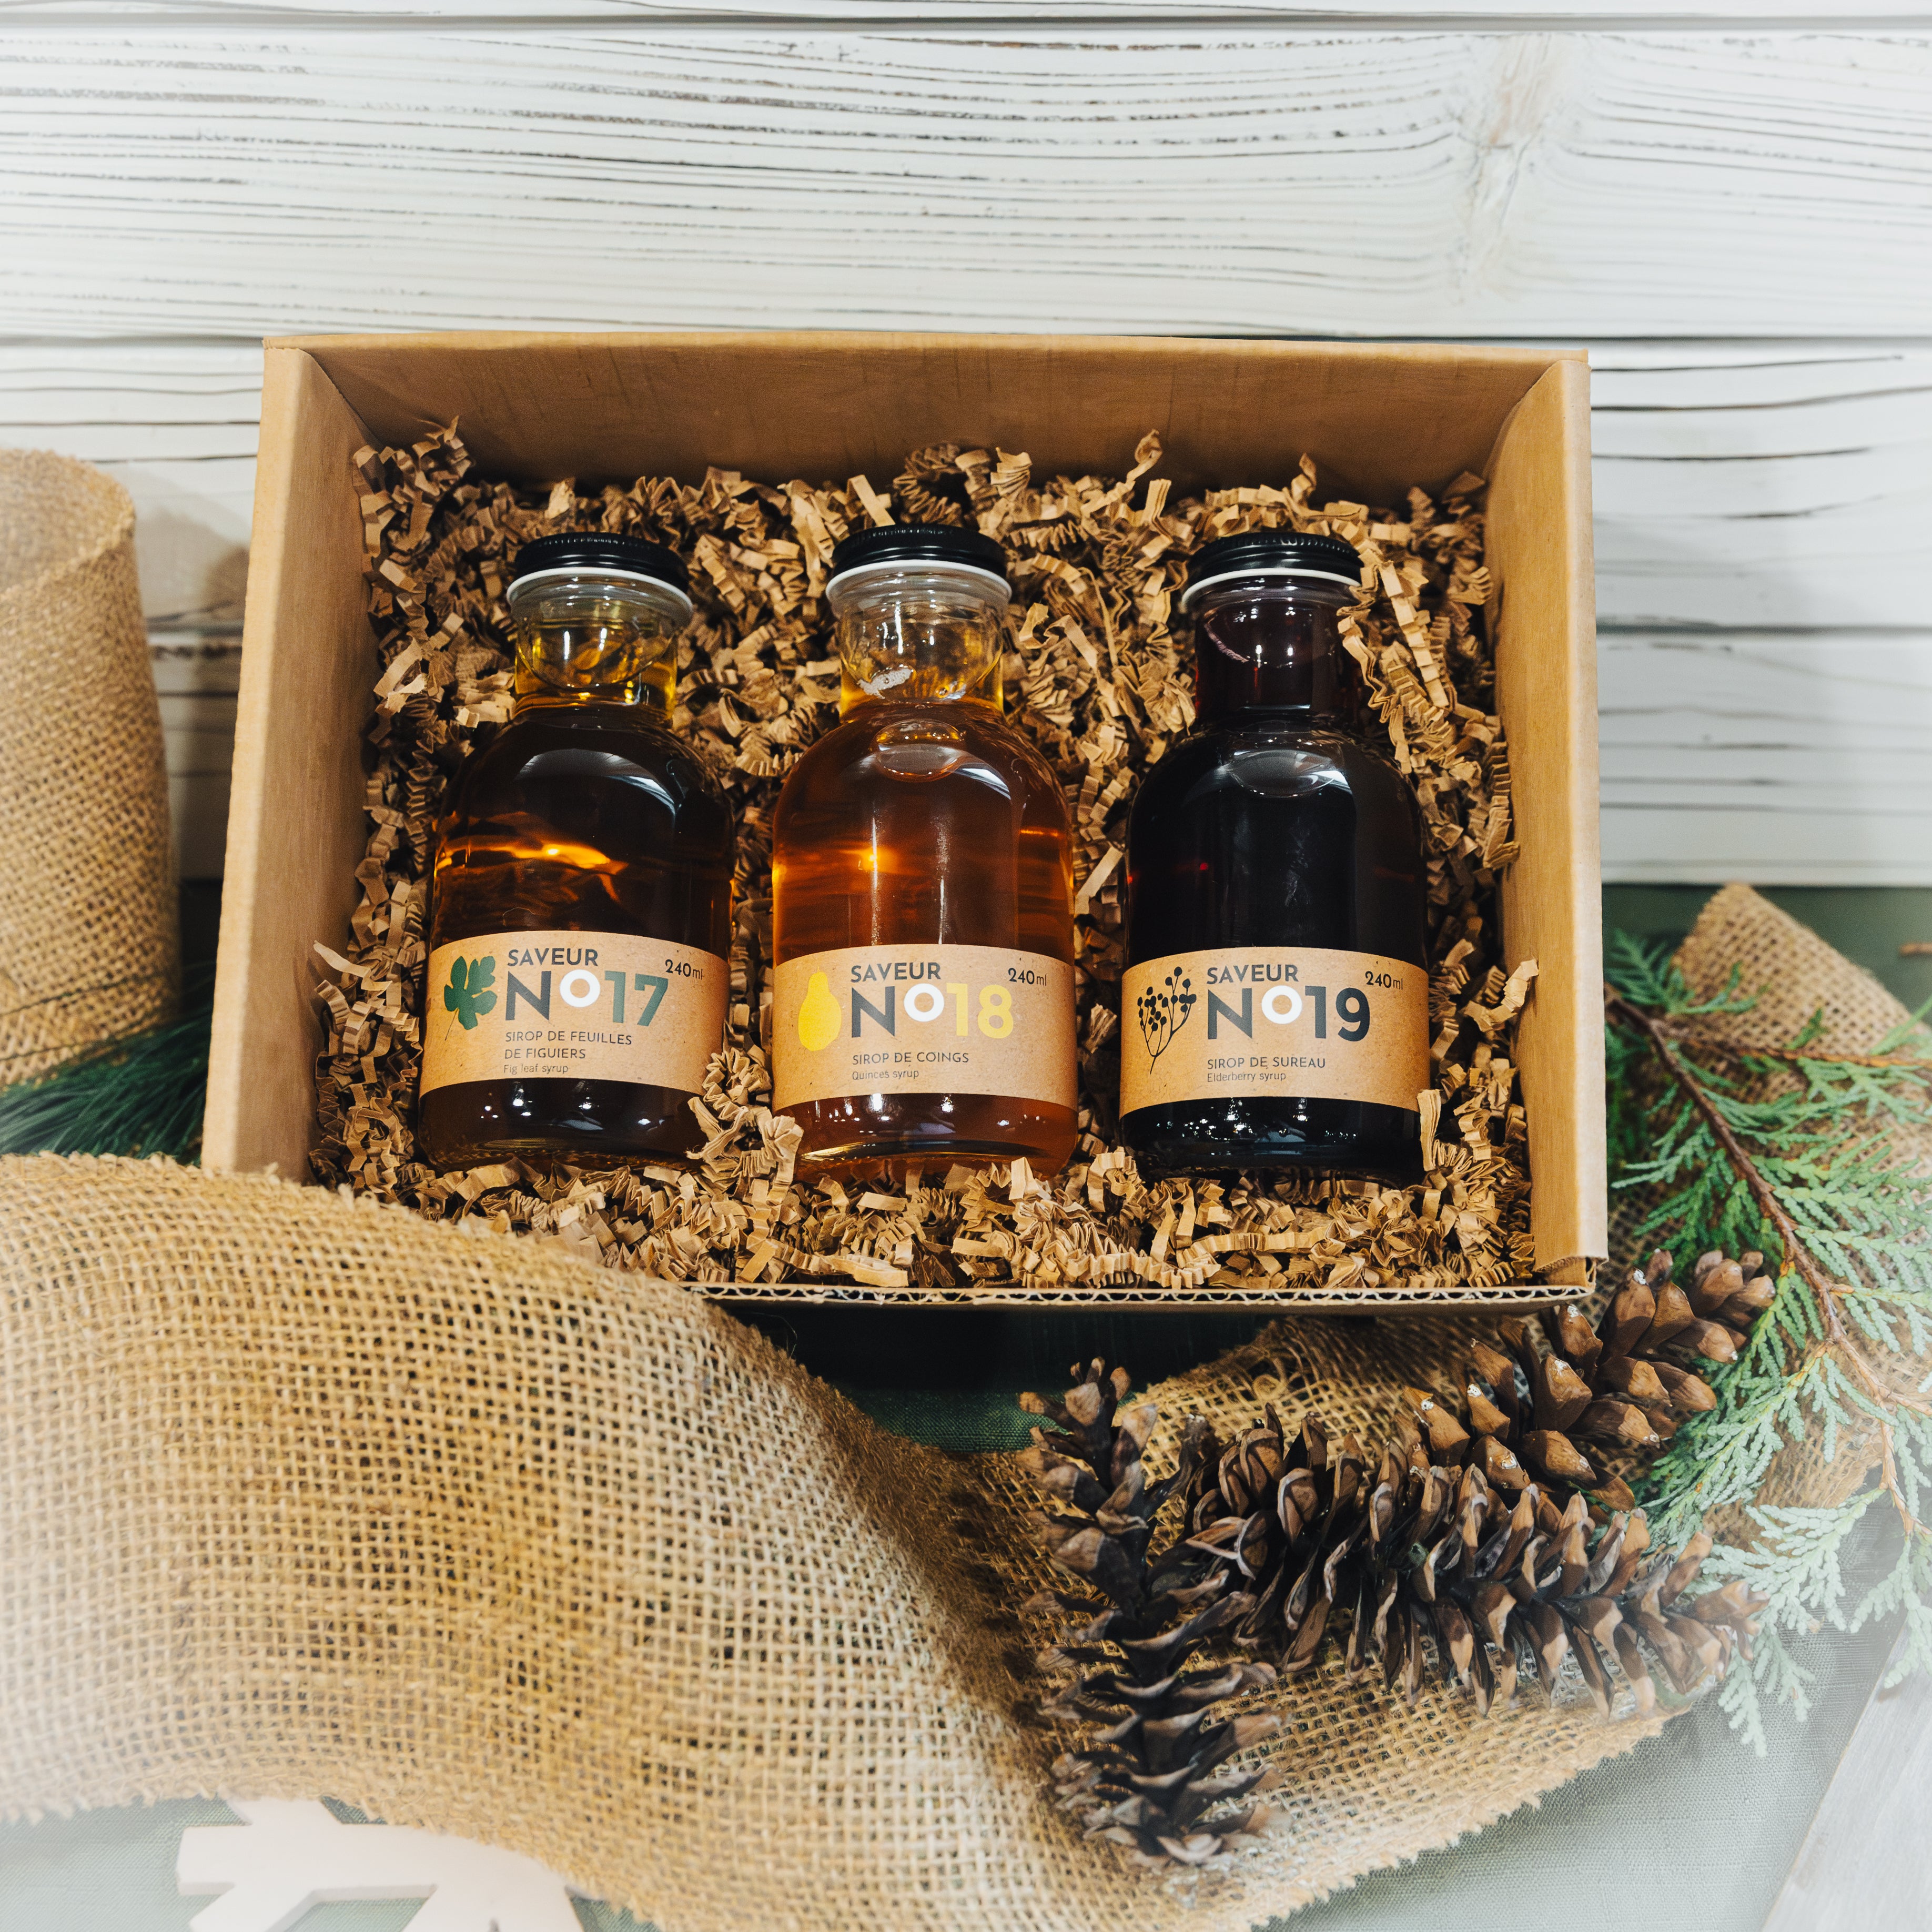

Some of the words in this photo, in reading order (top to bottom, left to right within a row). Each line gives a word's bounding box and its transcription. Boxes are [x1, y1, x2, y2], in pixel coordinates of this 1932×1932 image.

[507, 947, 599, 967] SAVEUR
[665, 959, 704, 980] 240ml
[851, 962, 941, 983] SAVEUR
[1008, 967, 1048, 987] 240ml
[1207, 964, 1299, 985] SAVEUR
[1365, 970, 1403, 990] 240ml
[505, 1031, 543, 1043] SIROP
[548, 1030, 566, 1041] DE
[570, 1031, 632, 1046] FEUILLES
[504, 1049, 522, 1059] DE
[526, 1047, 586, 1059] FIGUIERS
[852, 1053, 888, 1066] SIROP
[895, 1052, 912, 1063] DE
[917, 1051, 969, 1064] COINGS
[503, 1064, 518, 1075] Fig
[521, 1063, 539, 1073] leaf
[541, 1065, 569, 1075] syrup
[1207, 1057, 1245, 1070] SIROP
[1250, 1056, 1268, 1068] DE
[1273, 1057, 1326, 1069] SUREAU
[852, 1069, 889, 1081] Quinces
[893, 1070, 919, 1079] syrup
[1207, 1072, 1256, 1083] Elderberry
[1259, 1073, 1287, 1081] syrup
